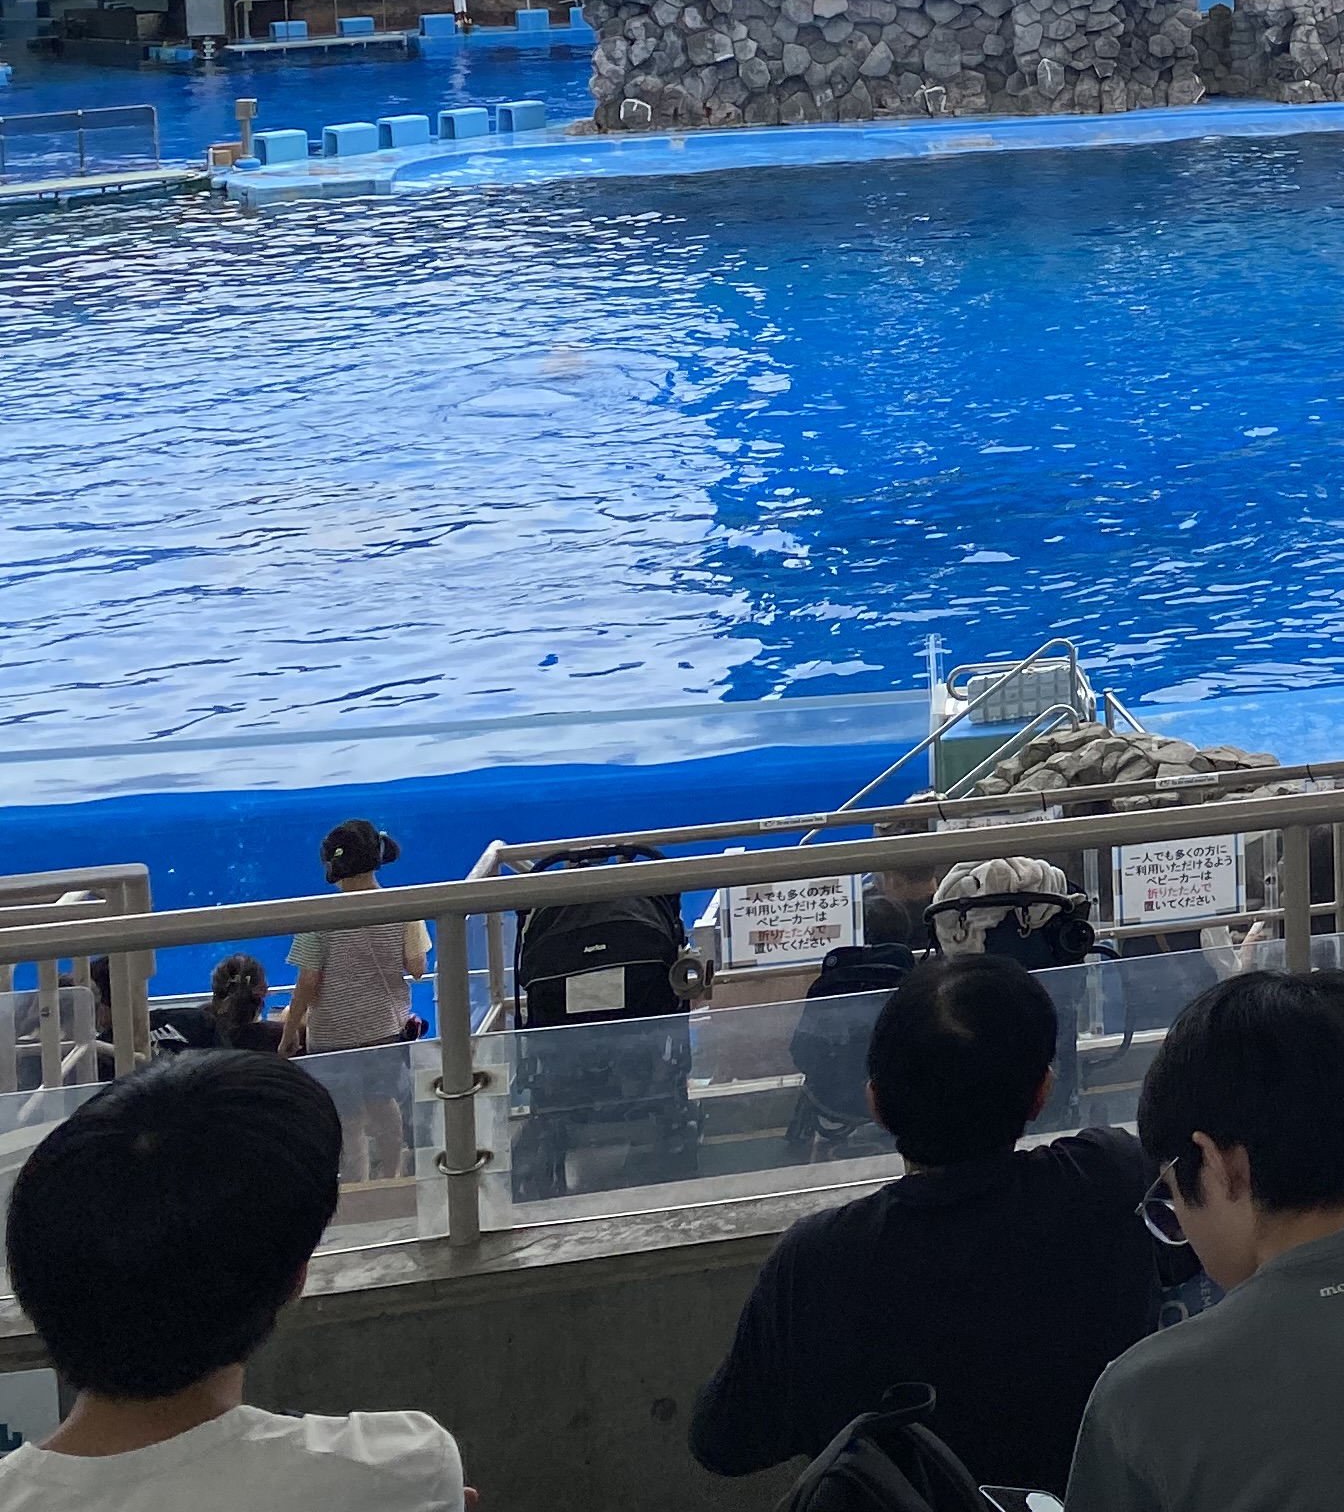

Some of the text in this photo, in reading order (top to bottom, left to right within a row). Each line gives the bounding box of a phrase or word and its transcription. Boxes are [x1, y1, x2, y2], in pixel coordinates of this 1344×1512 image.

[1130, 844, 1228, 863] 一人でも多くの方に
[1125, 855, 1233, 877] ご利用いただけるよう
[739, 884, 843, 904] 一人でも多くの方に
[1147, 883, 1212, 899] 折りたたんで
[733, 896, 849, 918] ご利用いただけるよう
[1144, 895, 1216, 912] 置いてください
[758, 925, 828, 942] 折りたたんで
[754, 937, 832, 955] 置いてください
